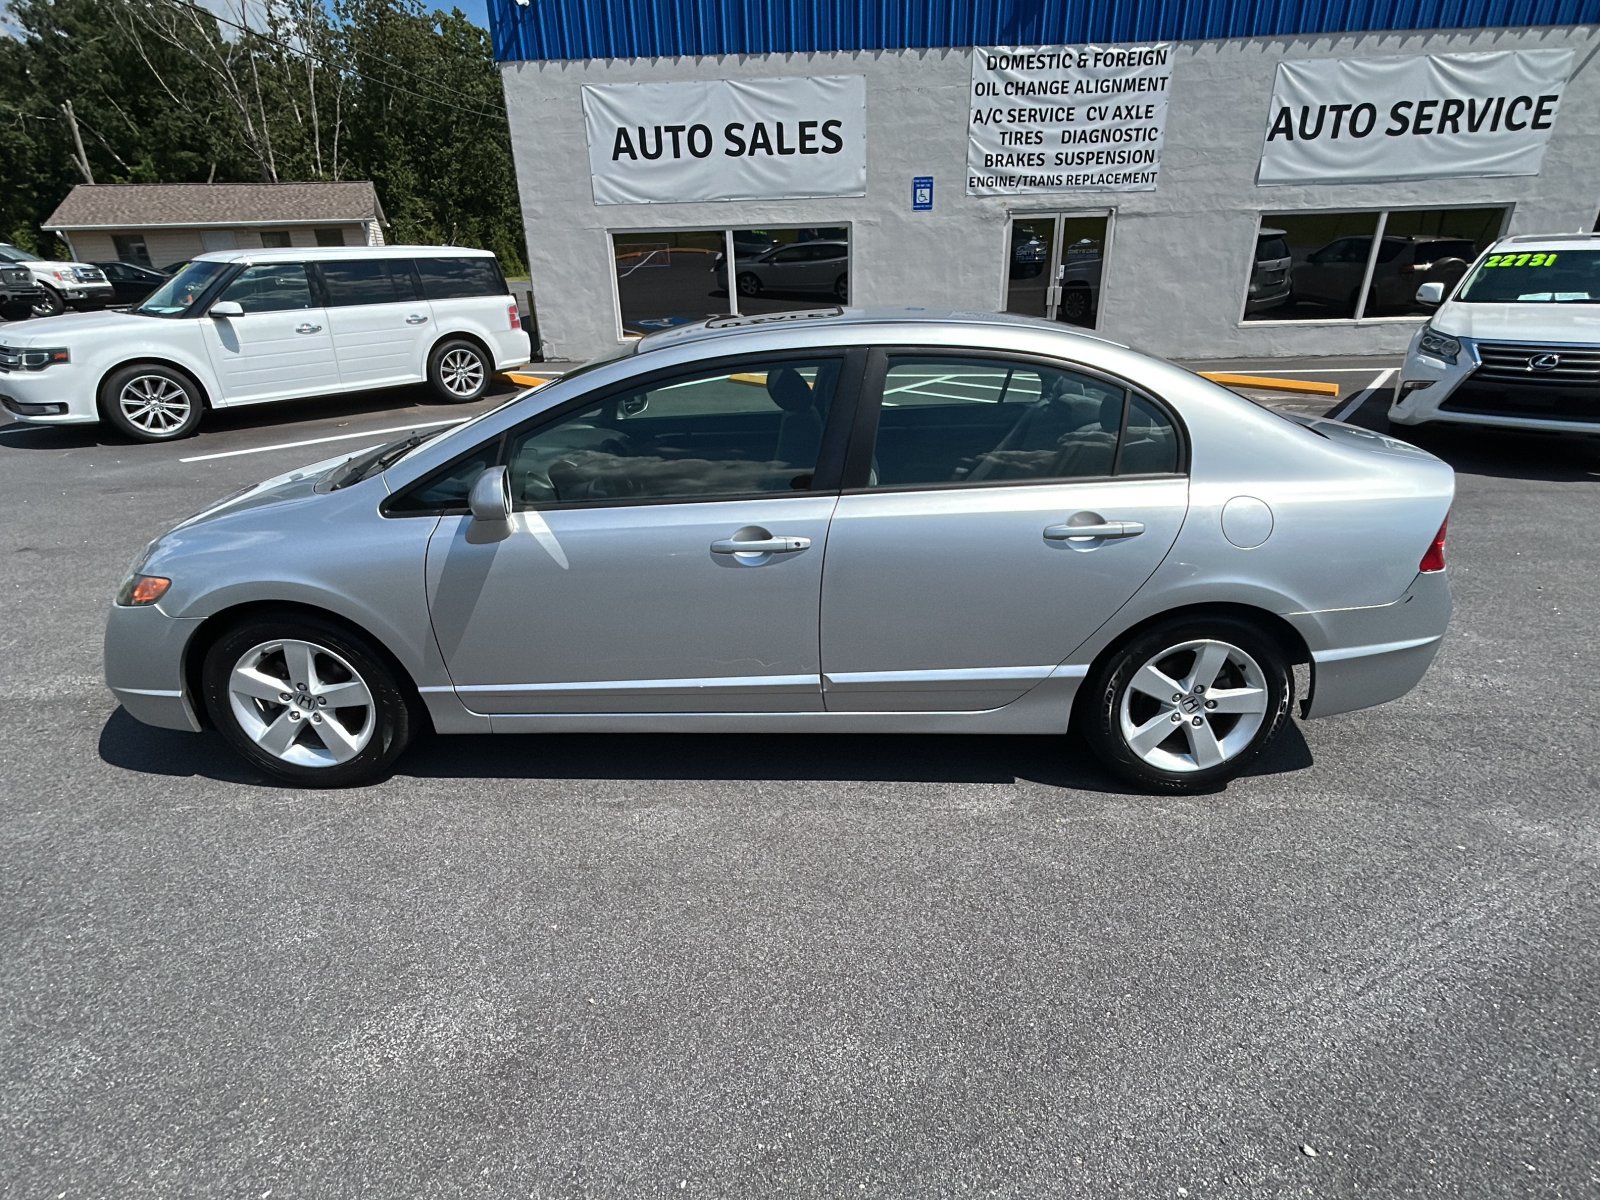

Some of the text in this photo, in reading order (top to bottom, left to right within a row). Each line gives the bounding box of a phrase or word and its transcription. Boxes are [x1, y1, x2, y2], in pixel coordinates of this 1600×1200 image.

[987, 50, 1168, 71] DOMESTIC & FOREIGN
[975, 76, 1169, 96] OIL CHANGE ALIGNMENT
[973, 104, 1154, 125] A/C SERVICE CV AXLE
[1266, 94, 1559, 142] AUTO SERVICE
[612, 119, 843, 161] AUTO SALES
[999, 127, 1159, 146] TIRES DIAGNOSTIC
[984, 149, 1155, 168] BRAKES SUSPENSION
[969, 171, 1158, 188] ENGINE/TRANS REPLACEMENT
[1484, 253, 1558, 268] 22731
